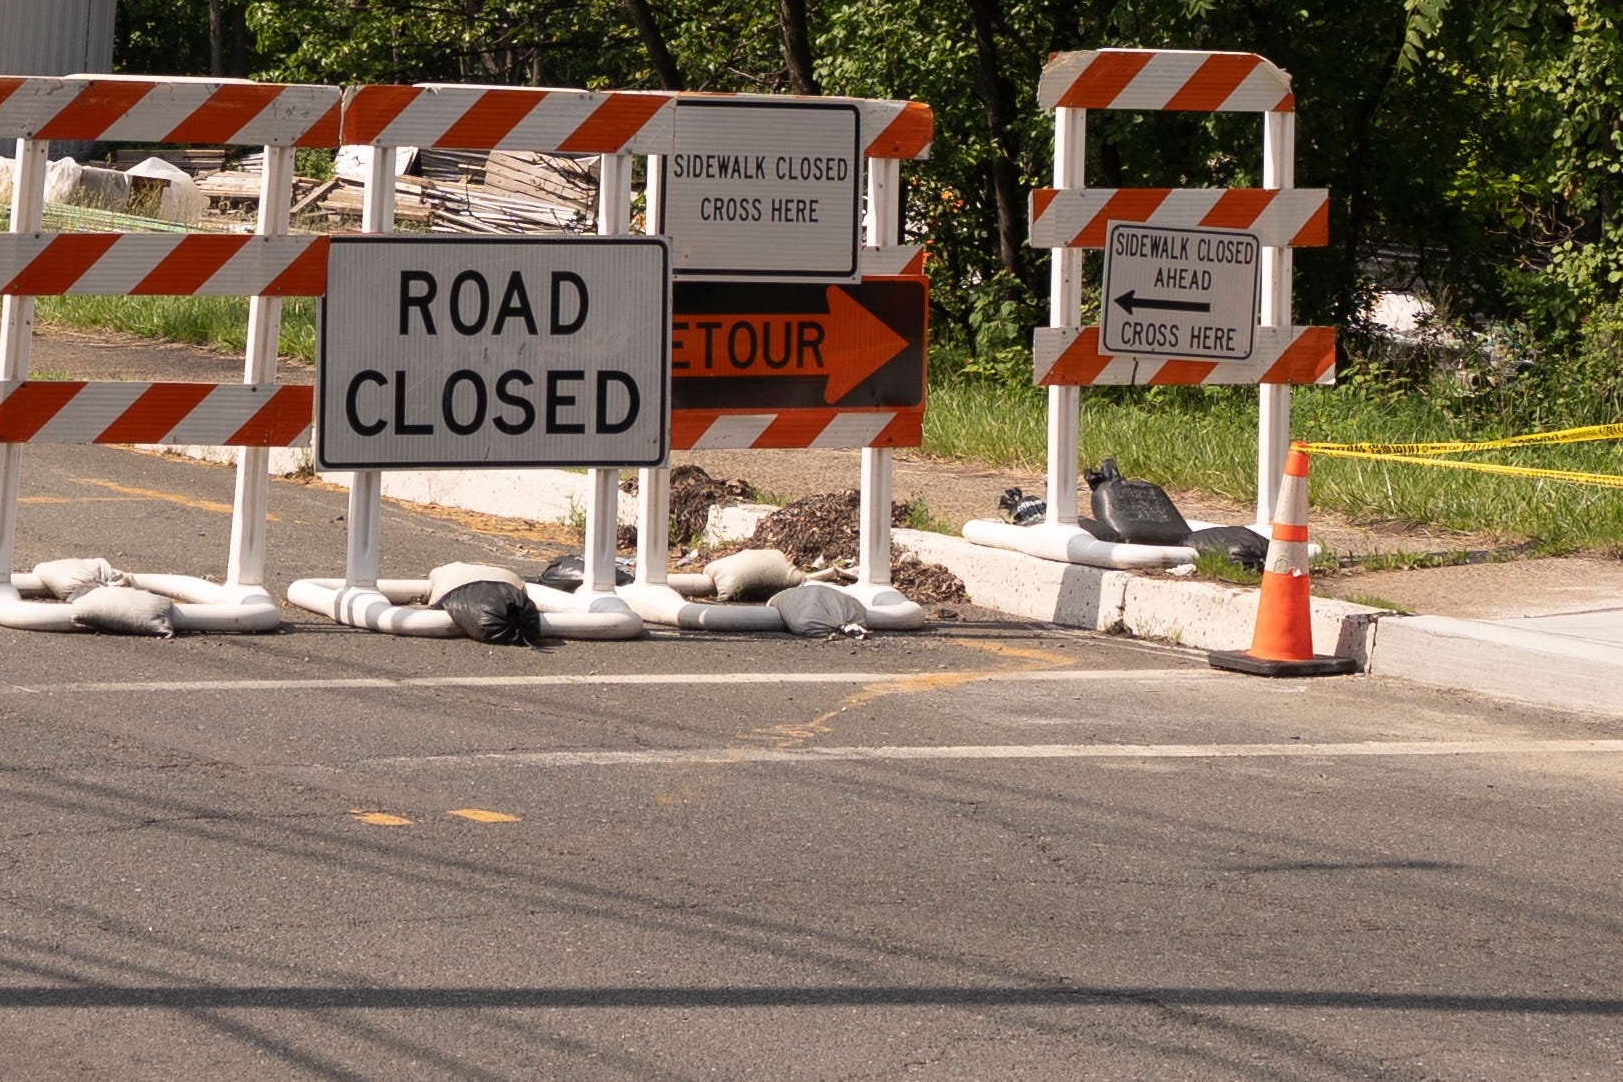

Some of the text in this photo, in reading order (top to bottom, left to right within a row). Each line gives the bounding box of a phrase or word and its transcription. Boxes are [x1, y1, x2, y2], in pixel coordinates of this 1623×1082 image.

[673, 154, 848, 182] SIDEWALK CLOSED
[700, 197, 820, 223] CROSS HERE
[1115, 232, 1254, 265] SIDEWALK CLOSED
[1154, 267, 1212, 291] AHEAD
[398, 268, 590, 337] ROAD
[672, 320, 826, 370] ETOUR
[1121, 321, 1237, 352] CROSS HERE
[344, 367, 641, 436] CLOSED
